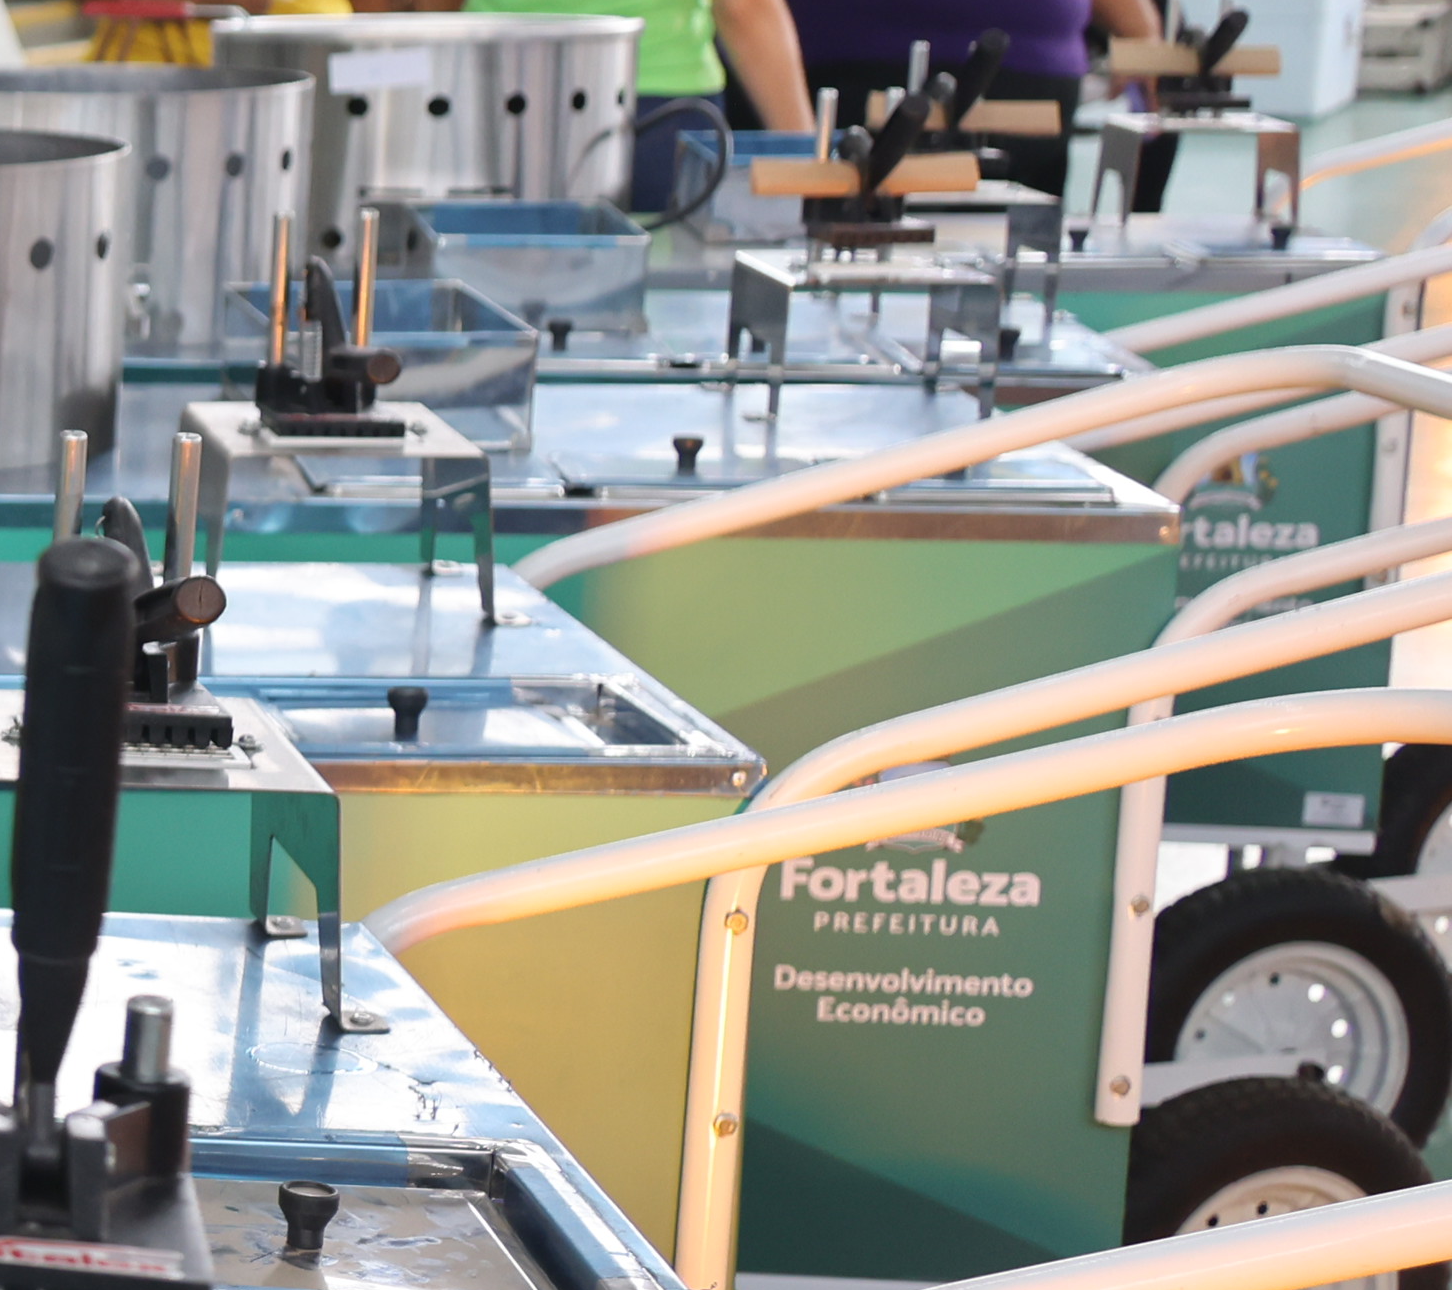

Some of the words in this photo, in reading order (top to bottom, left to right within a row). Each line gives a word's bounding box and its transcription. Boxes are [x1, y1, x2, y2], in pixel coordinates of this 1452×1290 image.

[780, 855, 1042, 908] Fortaleza
[812, 910, 1000, 937] PREFEITURA
[773, 963, 1035, 998] Desenvolvimento
[815, 995, 987, 1027] Econômico
